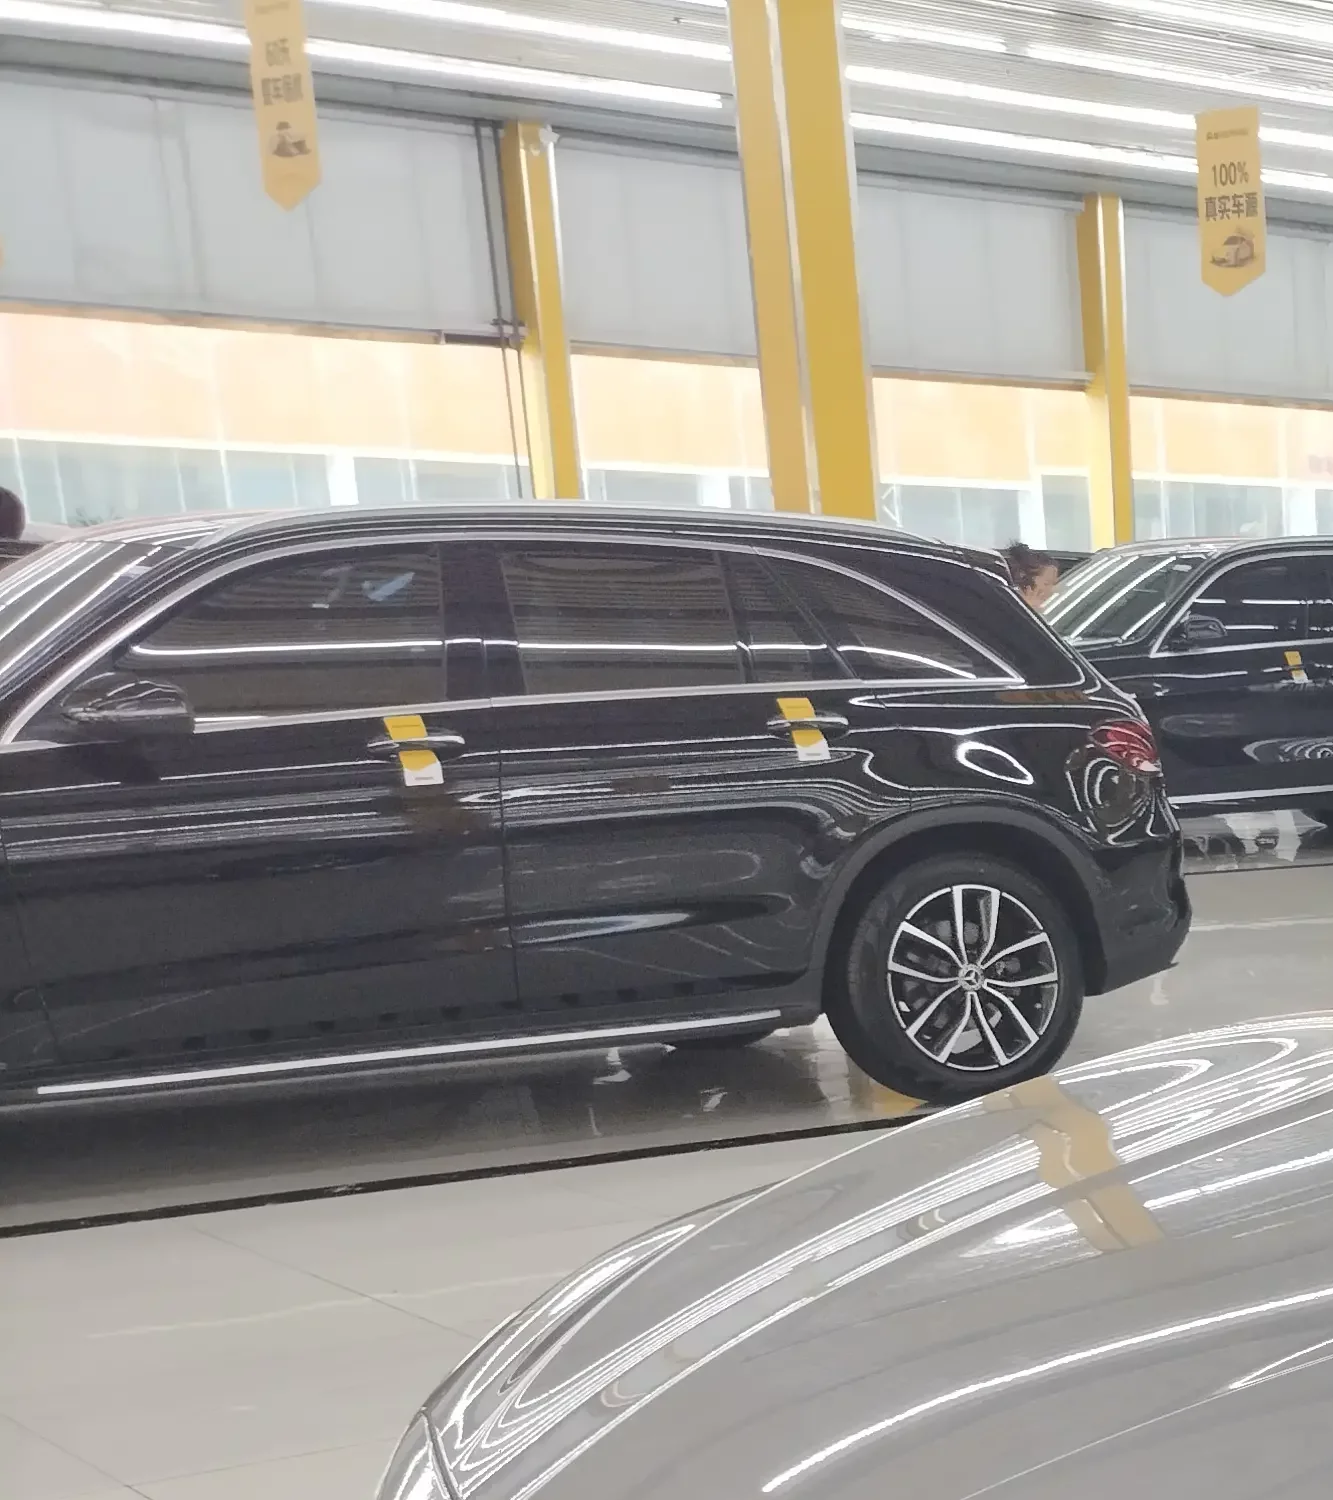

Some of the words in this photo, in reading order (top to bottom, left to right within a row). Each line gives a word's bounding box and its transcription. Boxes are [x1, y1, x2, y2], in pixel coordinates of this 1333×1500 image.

[1211, 161, 1249, 188] 100%
[1204, 192, 1259, 221] 真实车源
